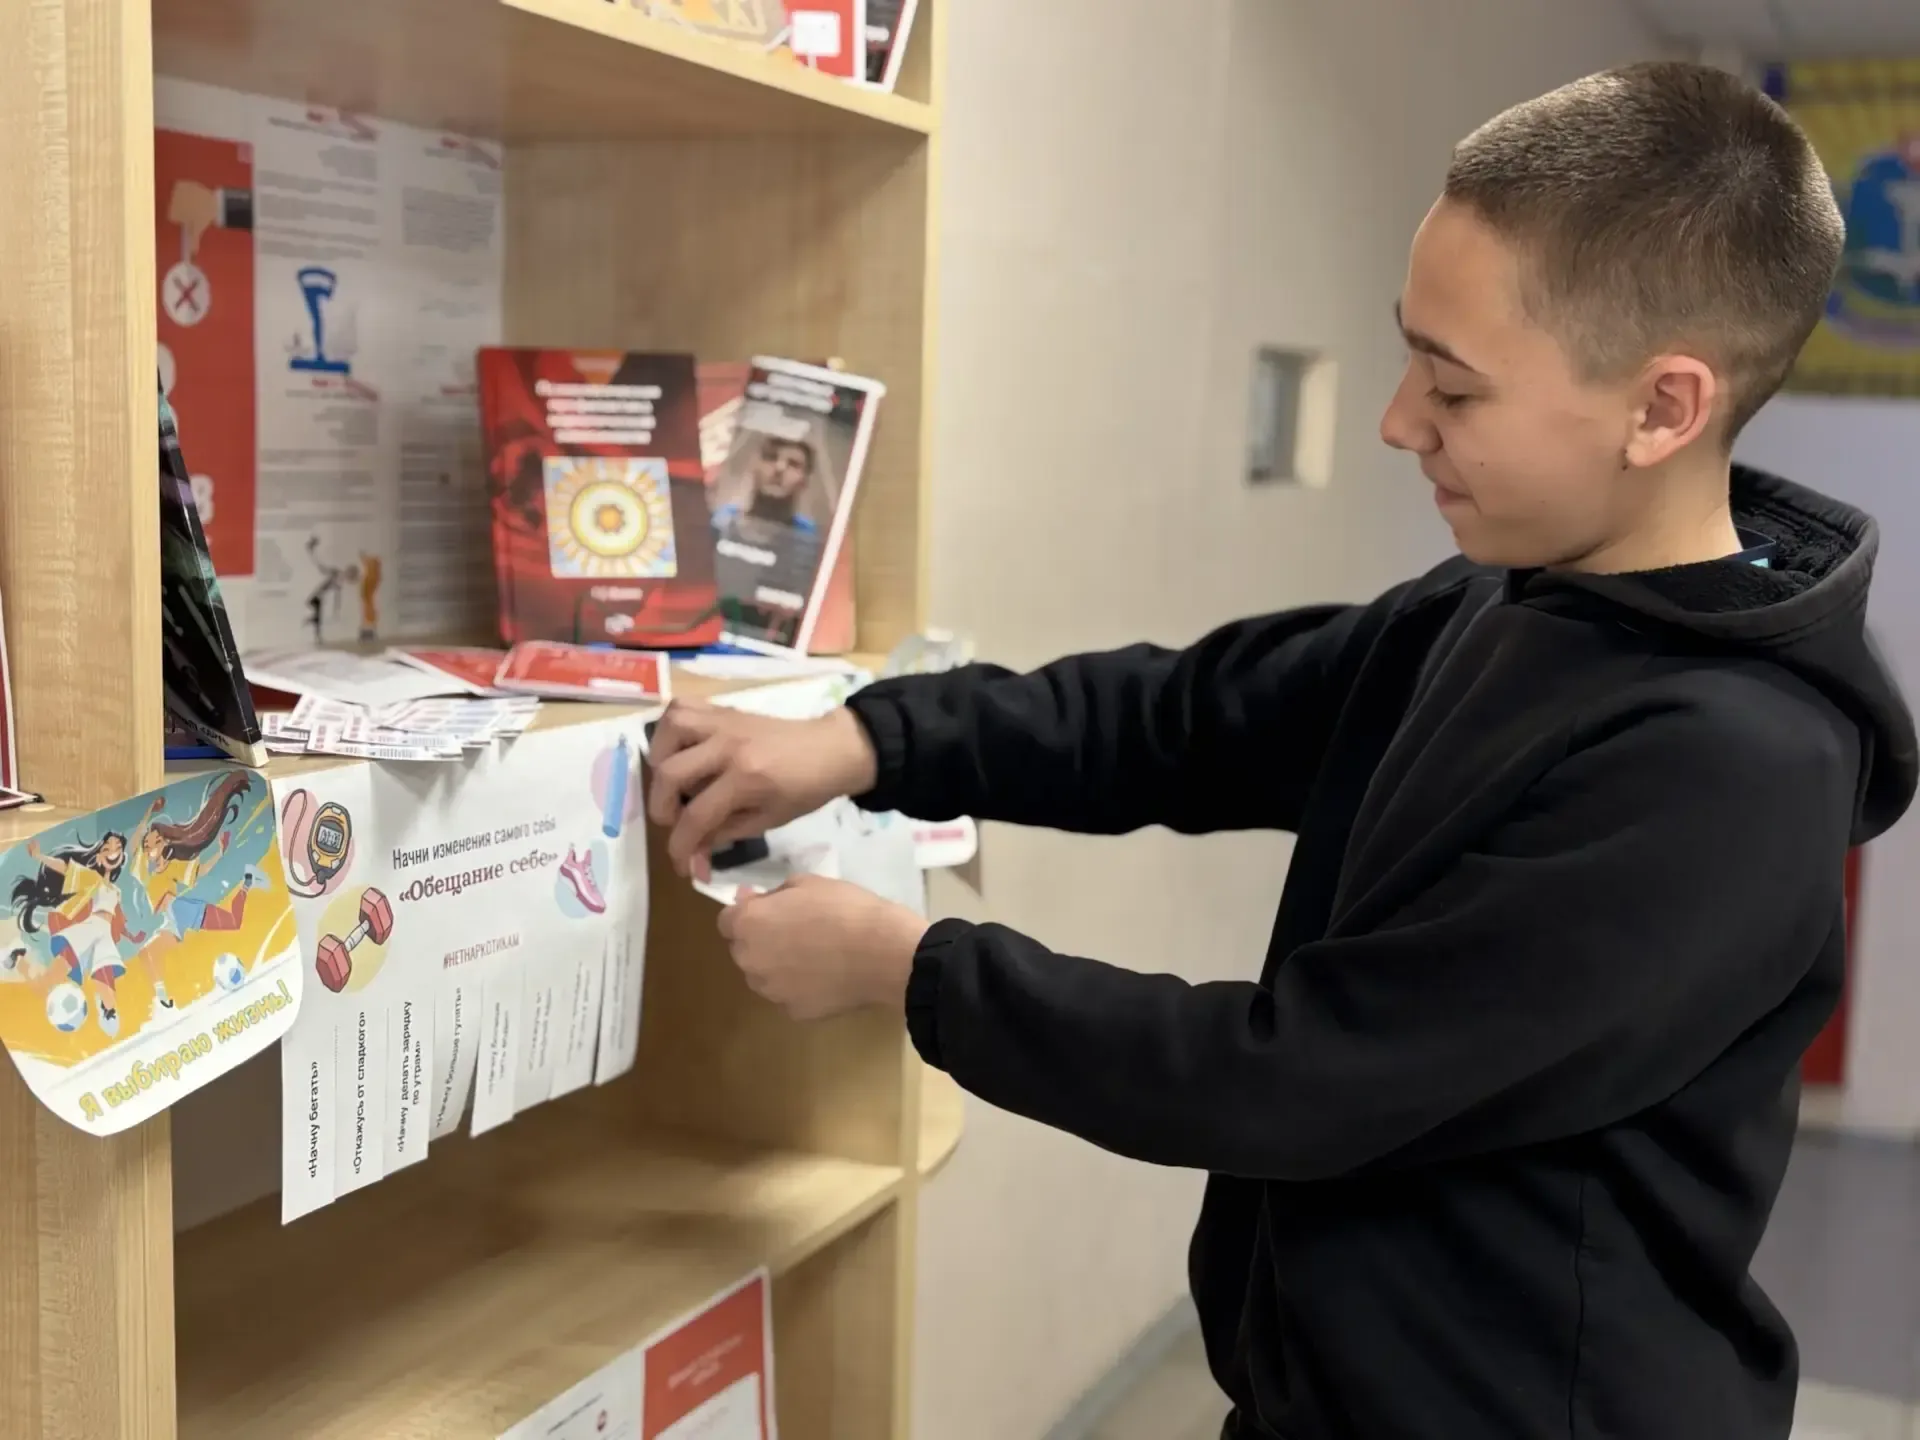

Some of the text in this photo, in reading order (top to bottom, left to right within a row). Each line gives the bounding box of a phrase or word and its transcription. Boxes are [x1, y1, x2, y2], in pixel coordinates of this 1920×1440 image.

[393, 814, 557, 870] Начни изменения самого себя
[398, 848, 559, 902] «Обещание себе»
[443, 932, 520, 970] #НЕТНАРКОТИКАМ
[79, 979, 294, 1122] Я выбираю жизнь!
[353, 1011, 367, 1174] «Откажусь от сладкого»
[397, 1001, 412, 1153] «Начну делать зарядку
[413, 1040, 422, 1088] утрам»
[308, 1061, 320, 1178] «Начну бегать»
